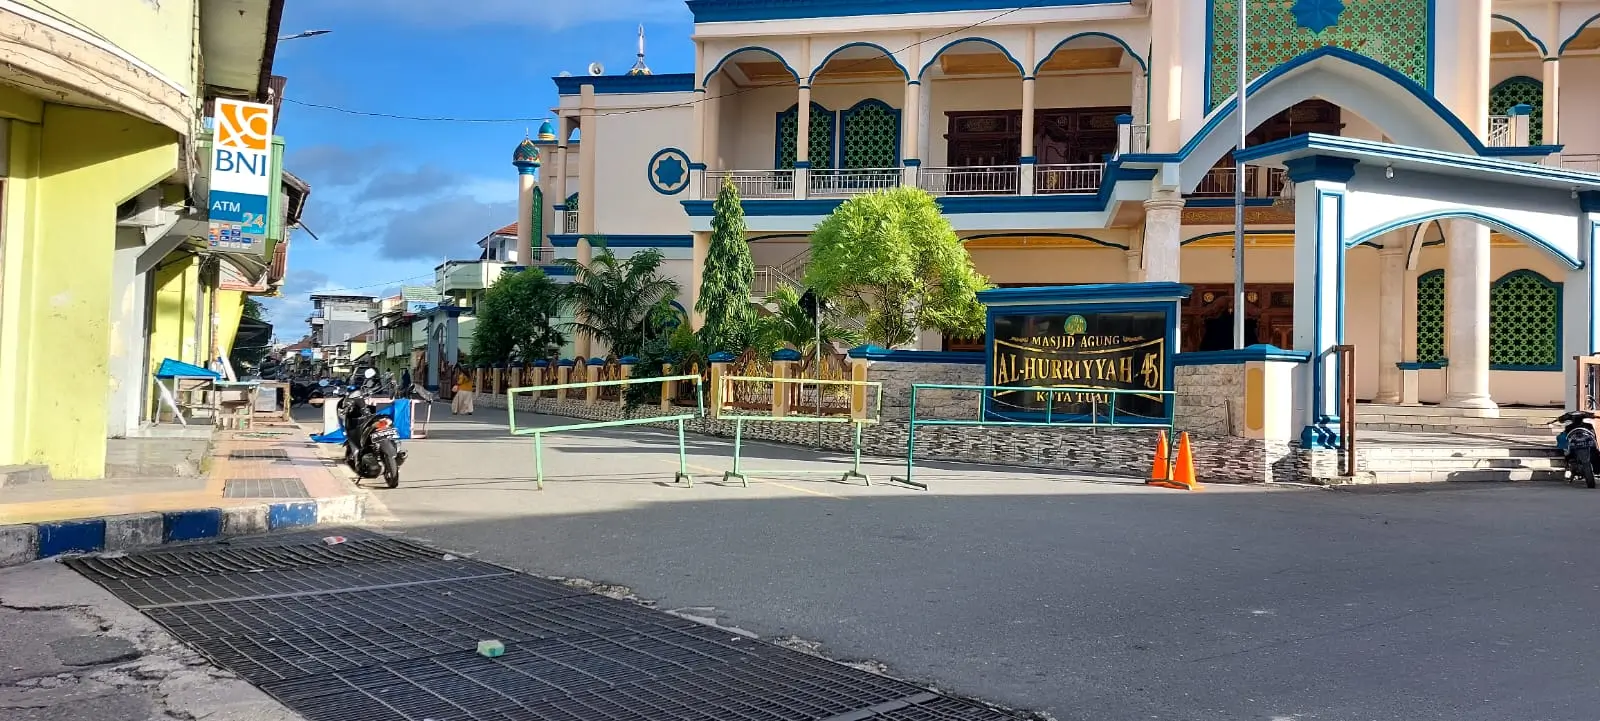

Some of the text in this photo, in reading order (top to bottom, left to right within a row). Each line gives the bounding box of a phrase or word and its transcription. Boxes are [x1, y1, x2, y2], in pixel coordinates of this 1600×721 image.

[215, 149, 266, 176] BNI
[212, 200, 241, 212] ATM
[242, 212, 264, 228] 24
[1032, 335, 1120, 350] MASJID AGUNG
